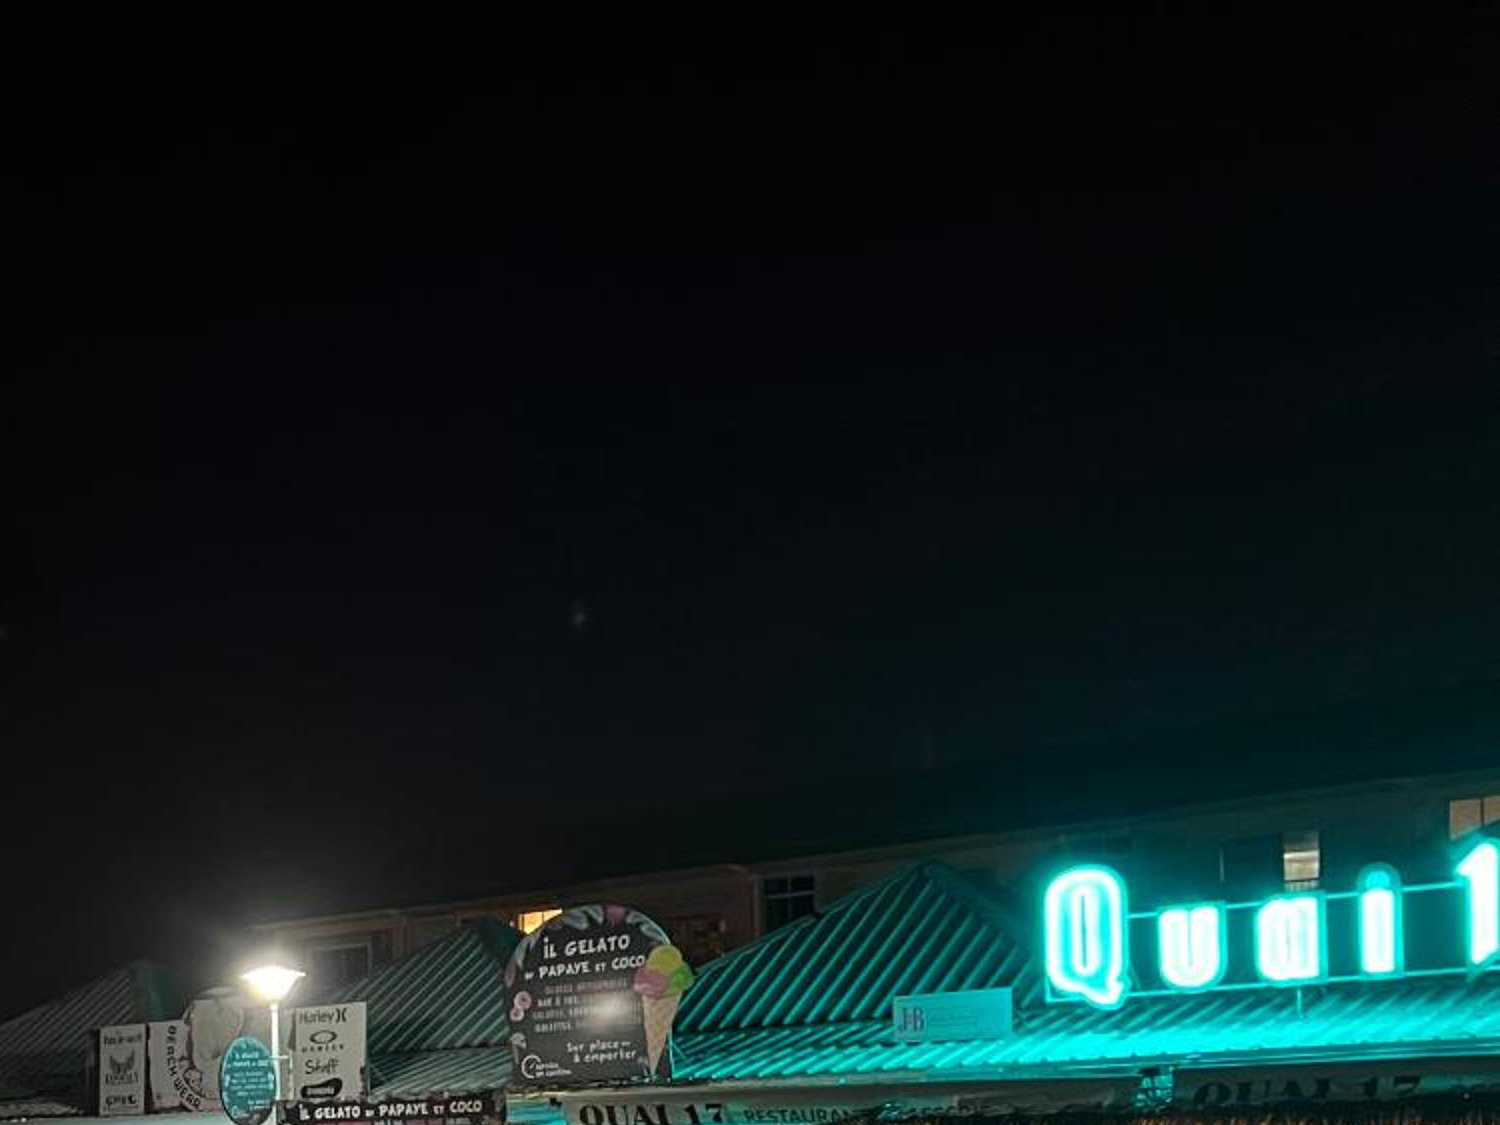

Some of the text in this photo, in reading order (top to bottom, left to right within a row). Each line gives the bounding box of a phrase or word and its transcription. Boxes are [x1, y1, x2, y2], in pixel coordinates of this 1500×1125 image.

[564, 934, 631, 957] GELATO
[1044, 865, 1398, 1007] Quai
[539, 961, 591, 979] PAPAYE
[611, 955, 645, 970] COCO
[315, 1106, 361, 1119] GELATO
[378, 1103, 428, 1117] PAPAYE
[450, 1101, 483, 1113] COCO
[683, 1103, 725, 1125] 17
[743, 1108, 856, 1125] RESTAURA
